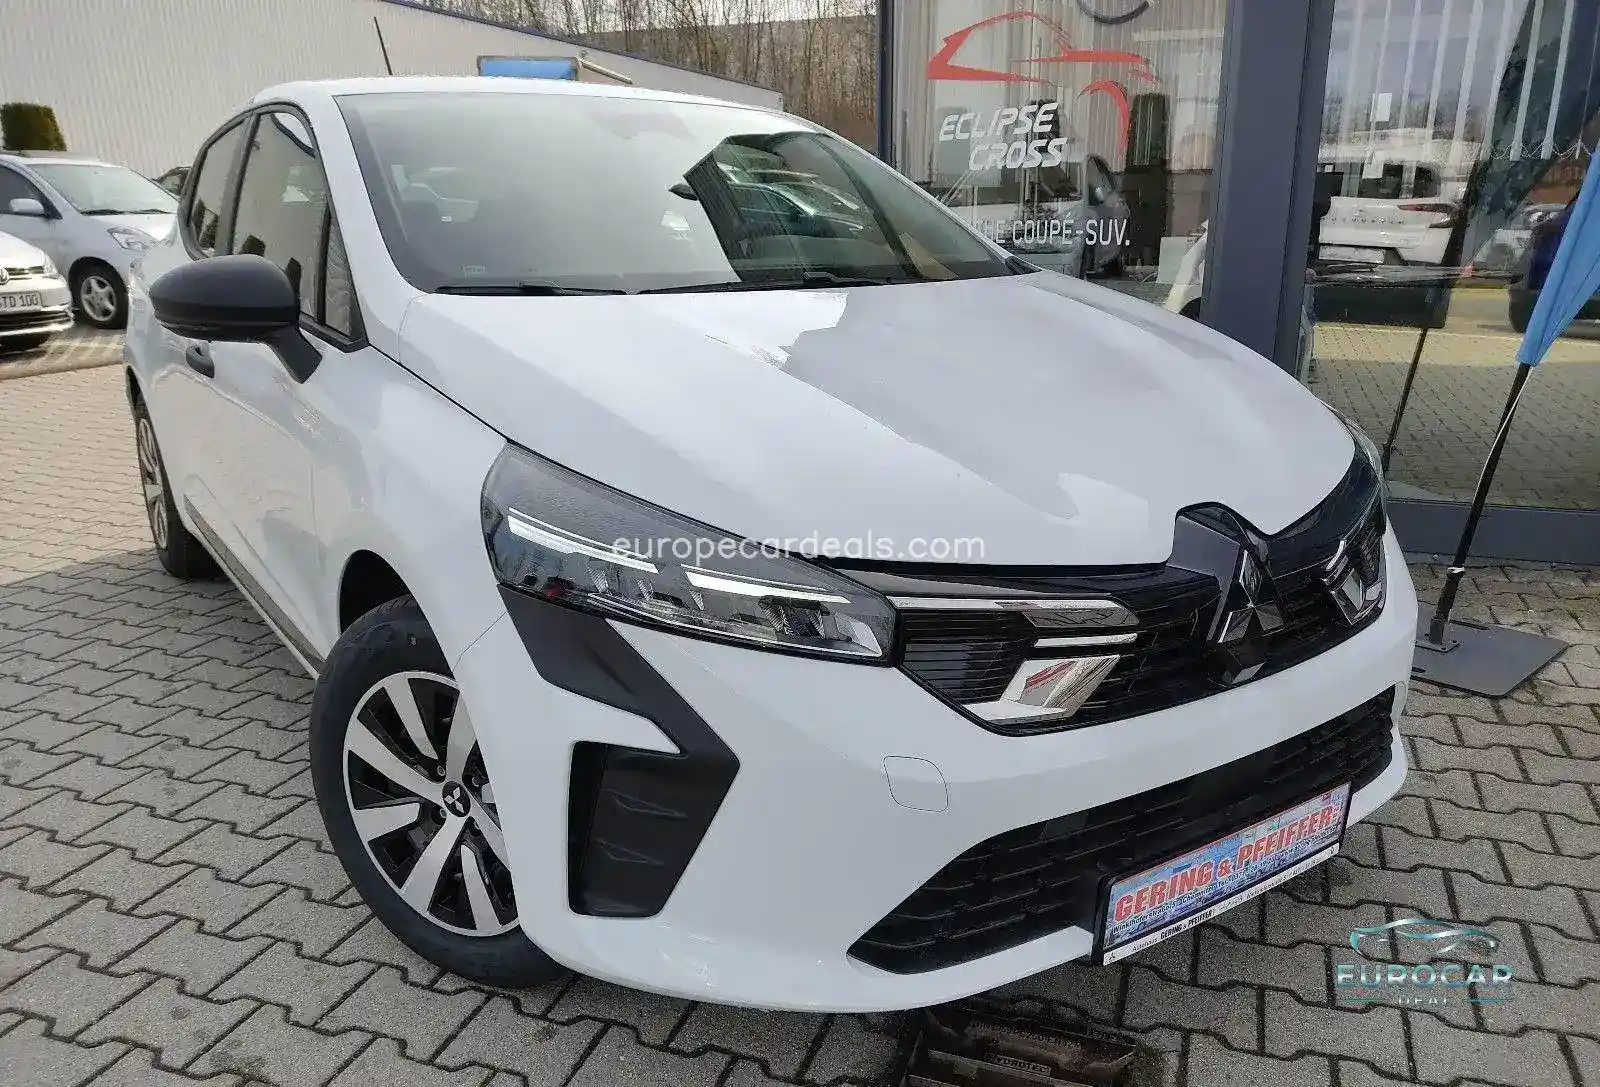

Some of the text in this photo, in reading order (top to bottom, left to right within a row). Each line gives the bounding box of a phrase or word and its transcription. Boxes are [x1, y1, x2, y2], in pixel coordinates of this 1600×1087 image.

[939, 103, 1059, 141] ECLIPSE
[969, 138, 1068, 170] CROSS
[1013, 213, 1130, 246] COUPÉ-SUV.
[20, 295, 38, 307] 100
[1114, 861, 1213, 921] GERING
[1217, 859, 1231, 878] &
[1236, 805, 1334, 871] PFEIFFER
[1188, 908, 1213, 928] PFEIFFER
